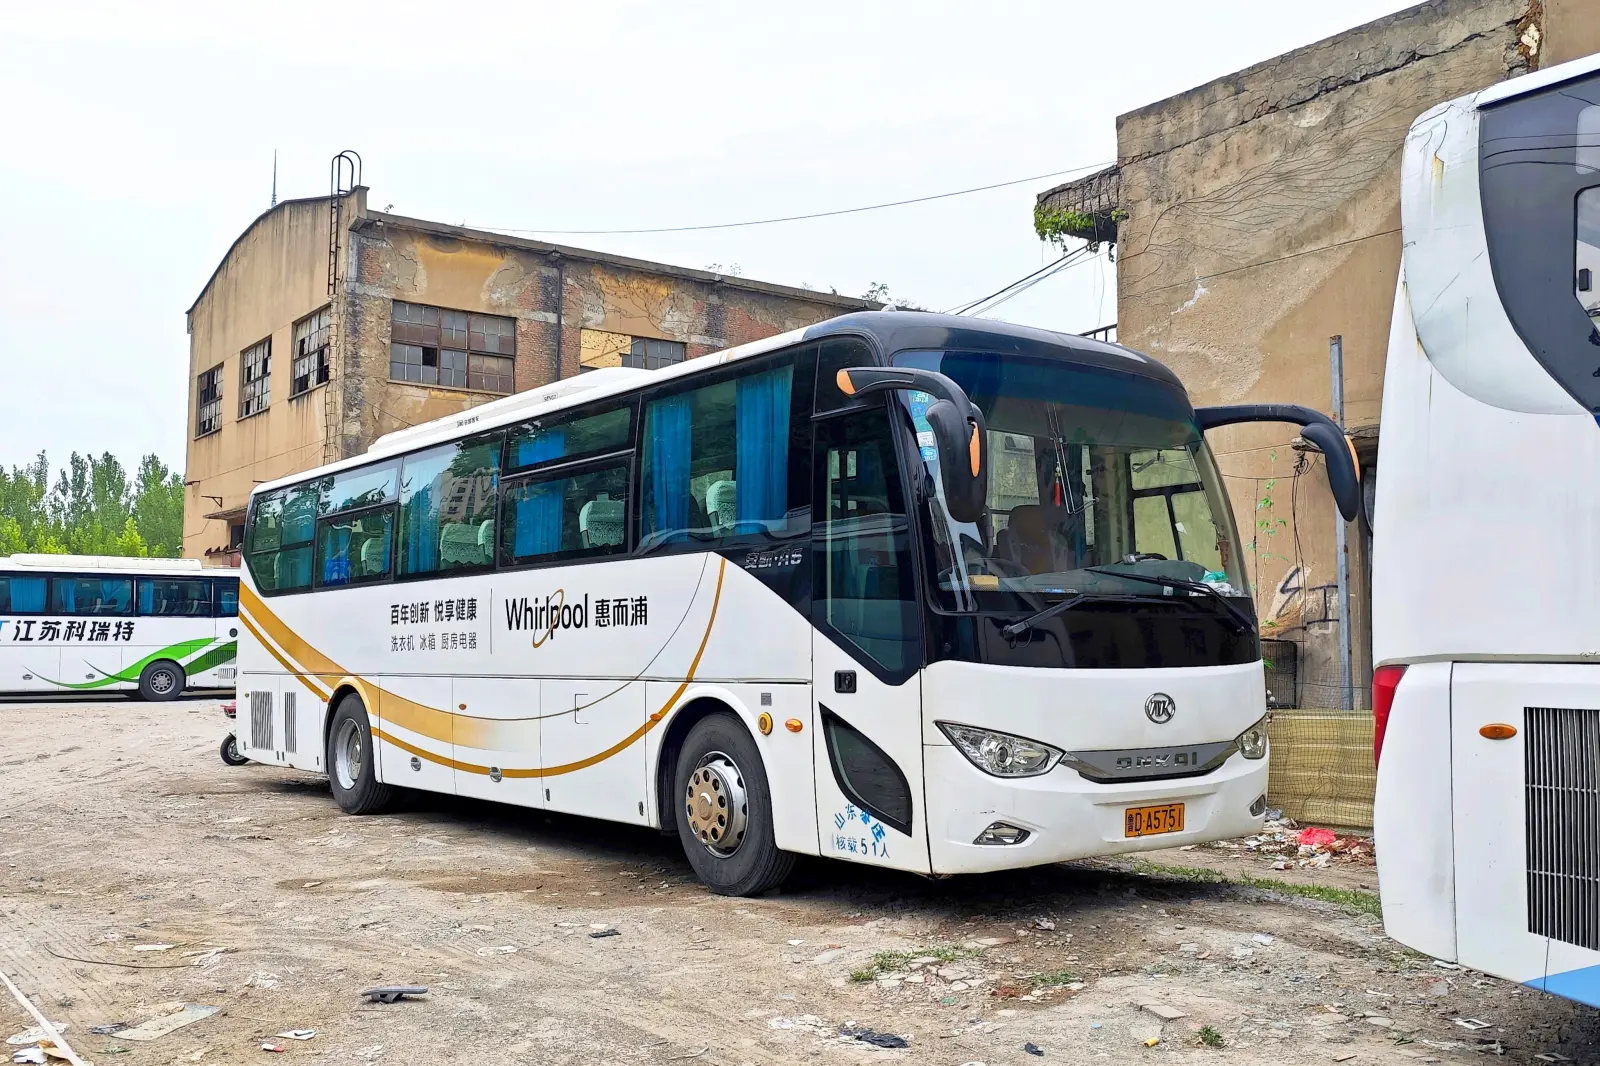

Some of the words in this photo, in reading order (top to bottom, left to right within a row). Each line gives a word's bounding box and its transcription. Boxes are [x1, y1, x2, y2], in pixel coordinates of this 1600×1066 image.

[390, 600, 430, 625] 百年创新
[434, 597, 477, 622] 悦享健康
[505, 593, 588, 640] Whirlpool
[595, 595, 648, 627] 惠而浦
[13, 620, 135, 641] 江苏科瑞特
[390, 634, 415, 652] 洗衣机
[419, 633, 436, 651] 冰箱
[441, 632, 477, 650] 厨房电器
